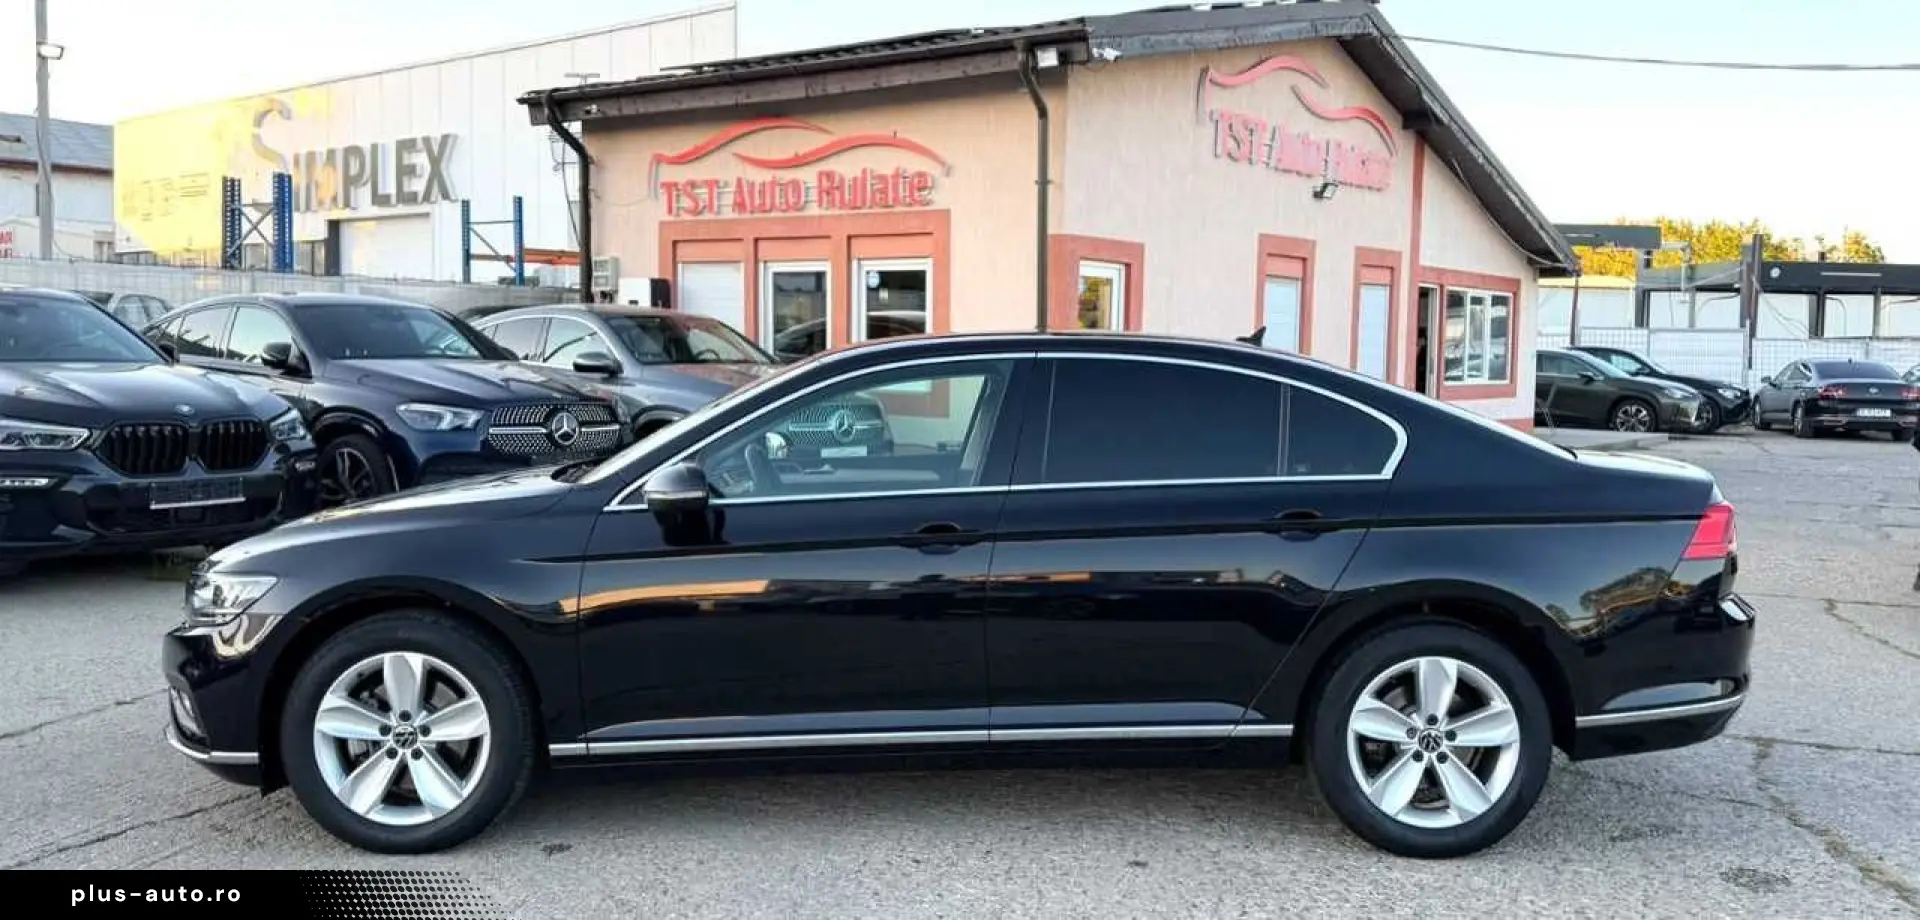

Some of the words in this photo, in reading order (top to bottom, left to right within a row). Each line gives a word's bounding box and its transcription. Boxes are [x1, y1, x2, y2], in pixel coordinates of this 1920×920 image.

[661, 179, 720, 217] TST
[732, 176, 805, 214] Auto
[816, 167, 935, 211] Rulate
